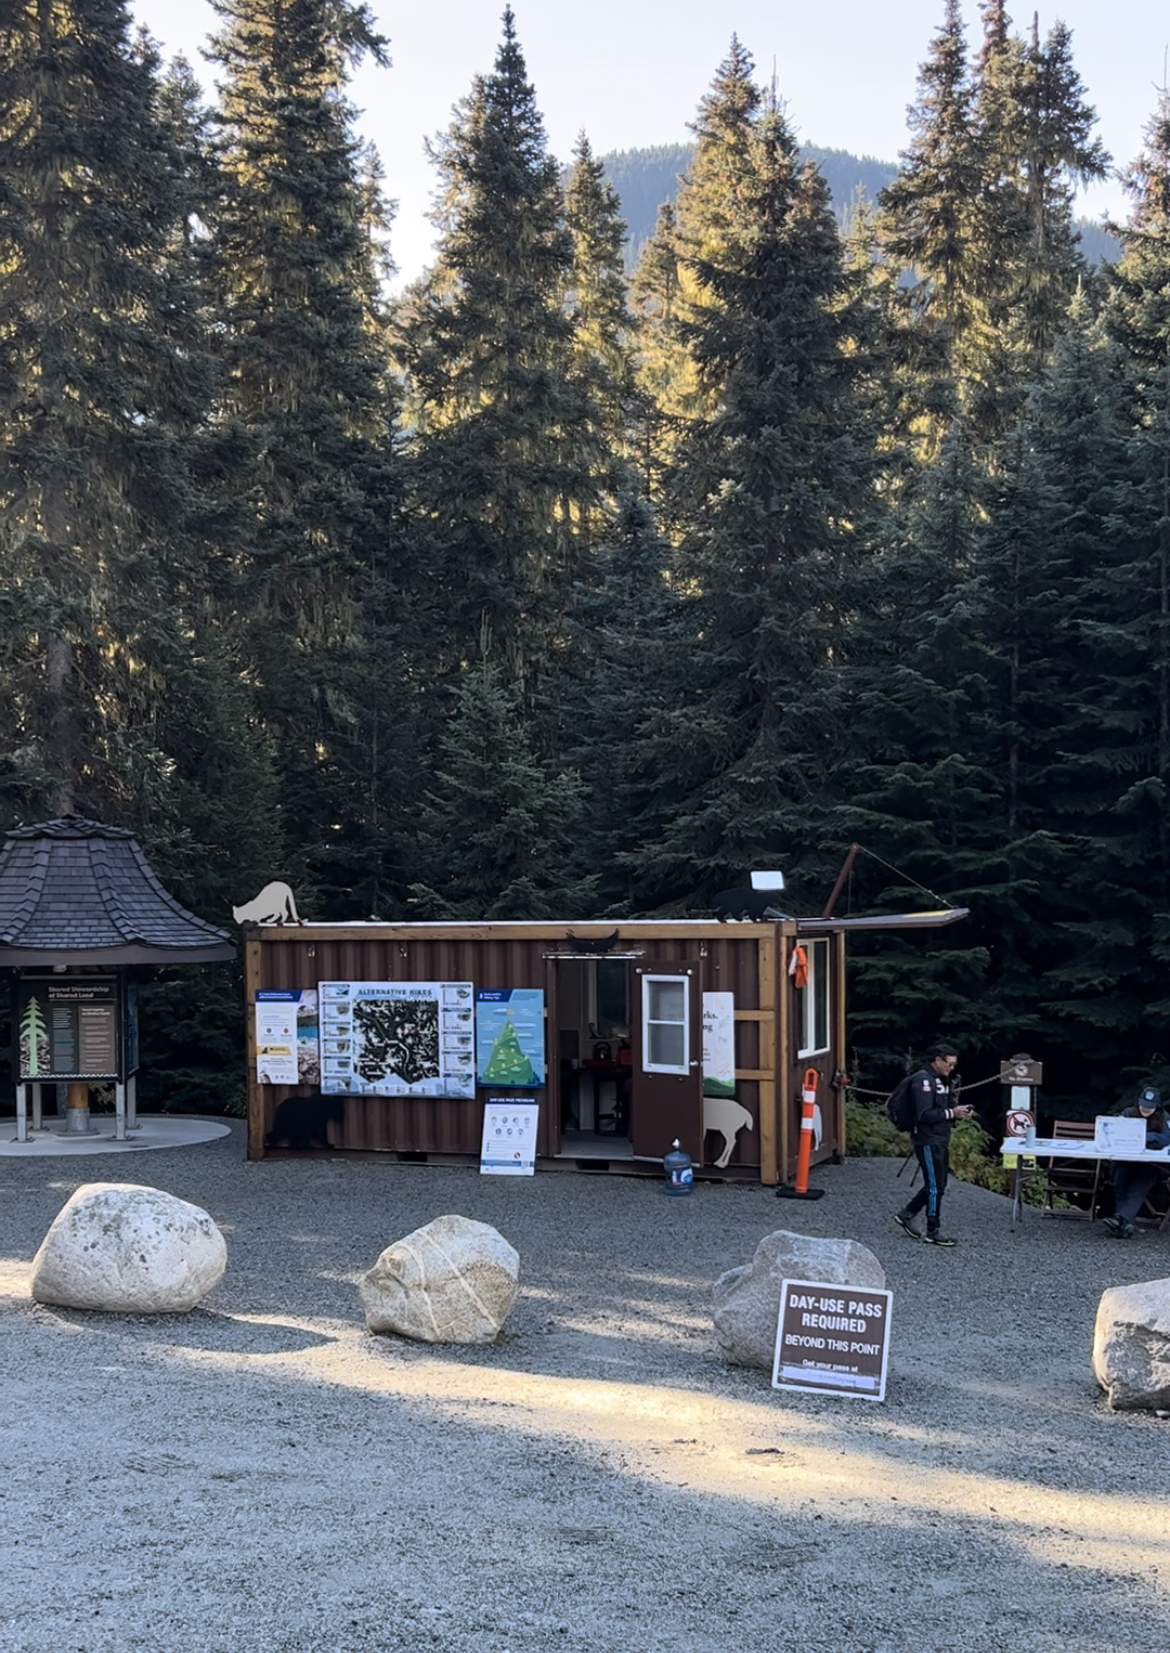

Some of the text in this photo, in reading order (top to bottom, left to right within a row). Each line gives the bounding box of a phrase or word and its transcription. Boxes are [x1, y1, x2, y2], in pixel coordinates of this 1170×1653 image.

[789, 1294, 883, 1318] DAY-USE PASS
[801, 1312, 867, 1333] REQUIRED
[785, 1334, 881, 1355] BEYOND THIS POINT
[802, 1358, 815, 1367] Get
[816, 1362, 832, 1370] your
[832, 1363, 850, 1372] pass
